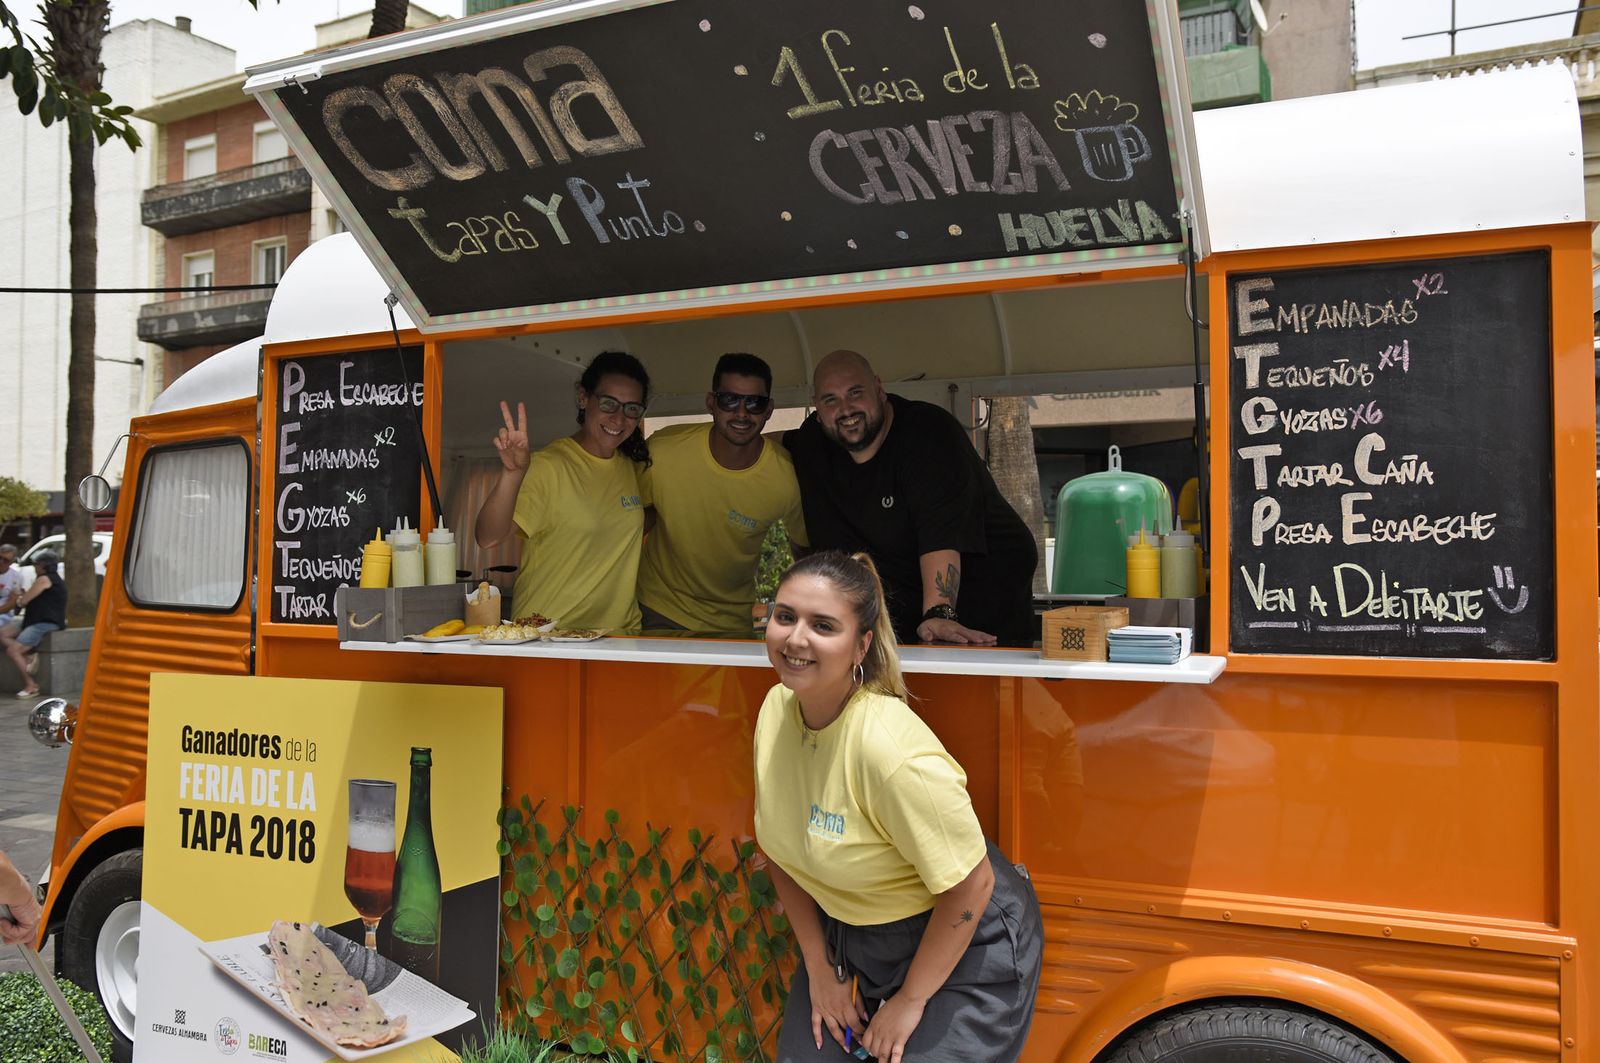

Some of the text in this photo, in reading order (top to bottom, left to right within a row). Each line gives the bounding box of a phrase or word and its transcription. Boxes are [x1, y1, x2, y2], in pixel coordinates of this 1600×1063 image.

[771, 46, 843, 119] 1
[943, 26, 988, 93] de
[991, 22, 1040, 90] la
[322, 45, 646, 192] coma
[808, 109, 1072, 205] CERVEZA
[998, 199, 1173, 252] HUELVA
[1310, 585, 1328, 617] A
[181, 725, 316, 763] Ganadores de la
[179, 762, 316, 812] FERIA DE LA
[179, 808, 316, 864] TAPA 2018
[152, 1023, 177, 1036] CERVEZAS
[179, 1028, 207, 1042] ALHAMBRA
[248, 1033, 287, 1057] BARECA
